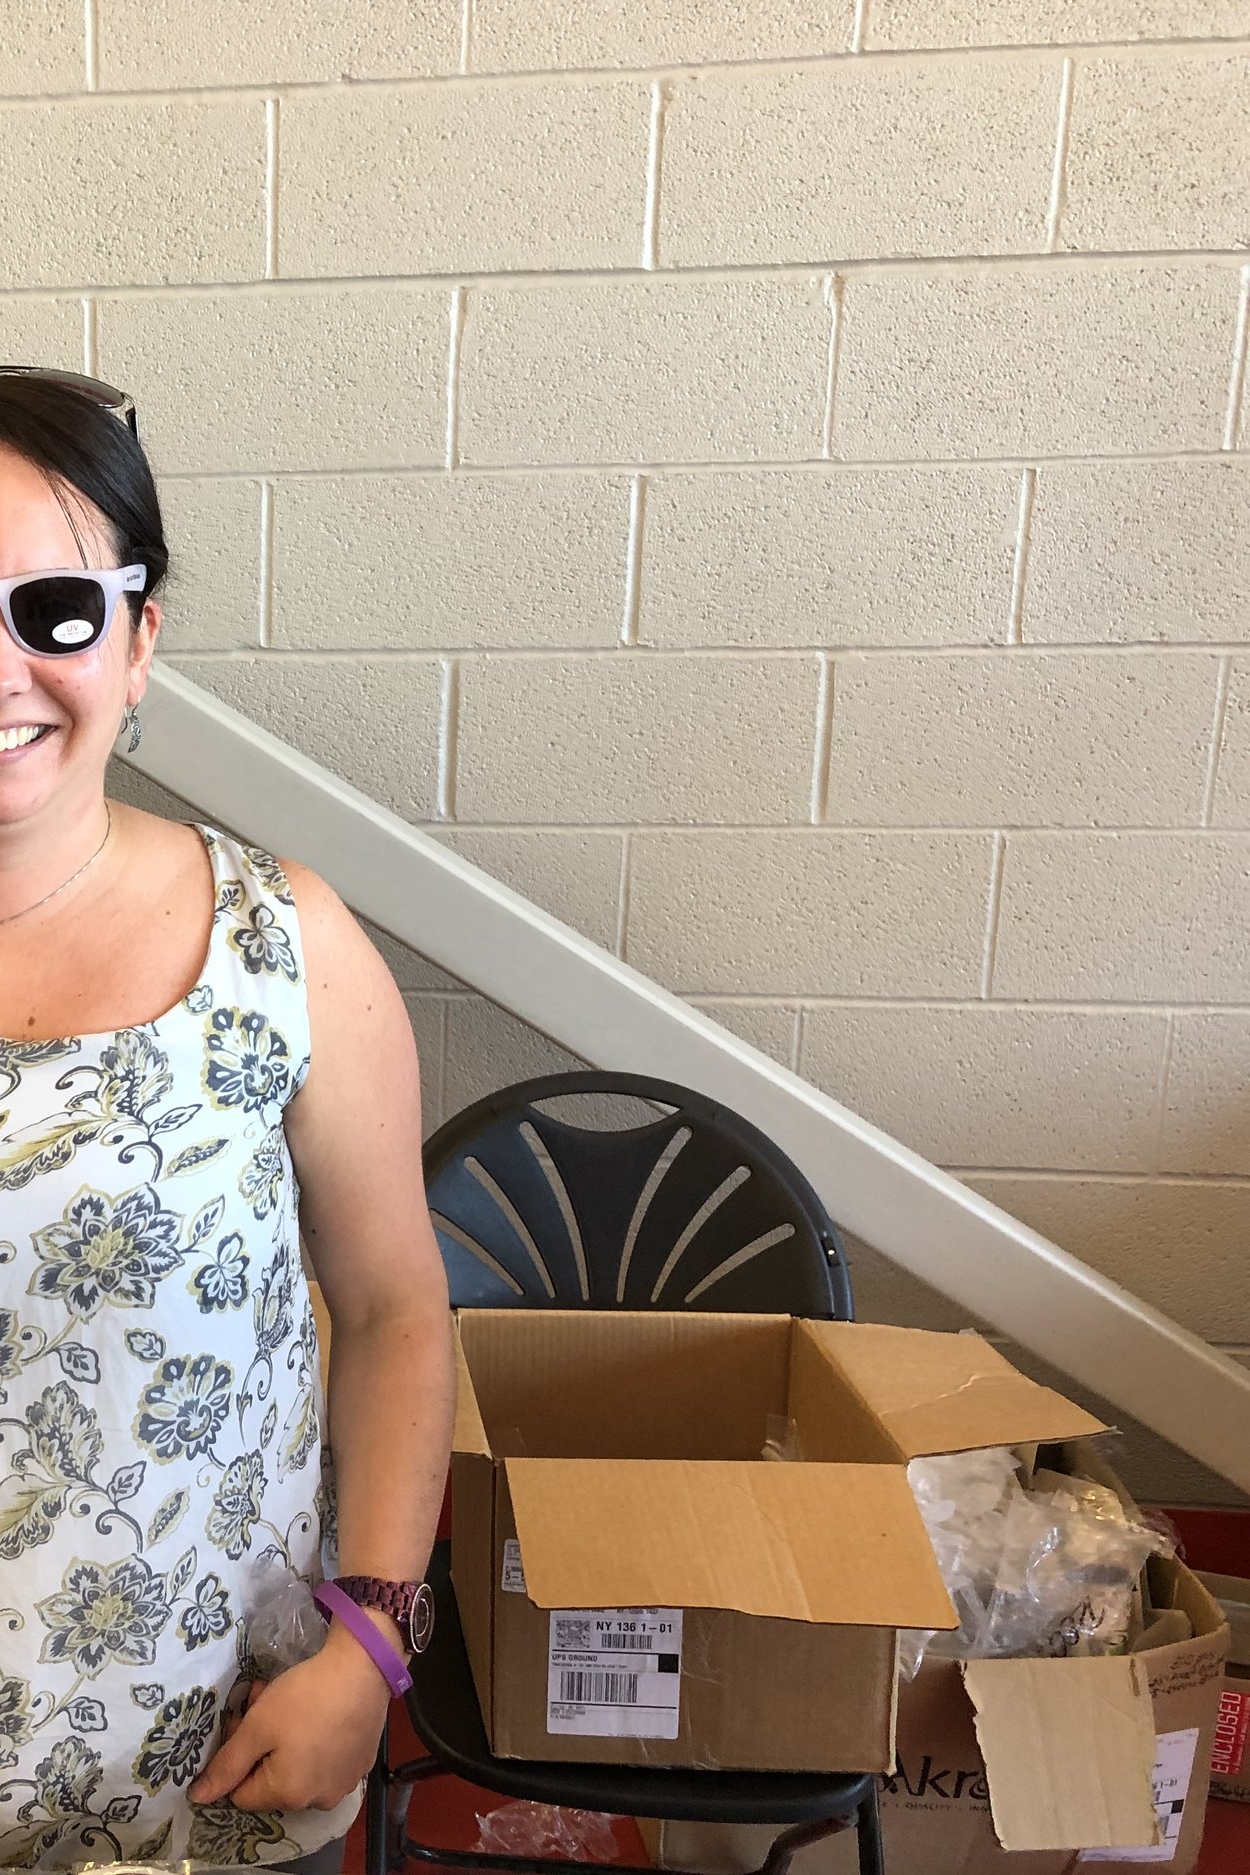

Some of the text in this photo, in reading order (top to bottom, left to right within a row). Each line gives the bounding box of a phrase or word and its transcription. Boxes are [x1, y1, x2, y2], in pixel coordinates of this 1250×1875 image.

[66, 624, 79, 632] UV
[596, 1621, 612, 1631] NY
[617, 1622, 636, 1632] 136
[552, 1653, 598, 1662] UPS GROUND
[1211, 1692, 1242, 1774] ENCLOSED
